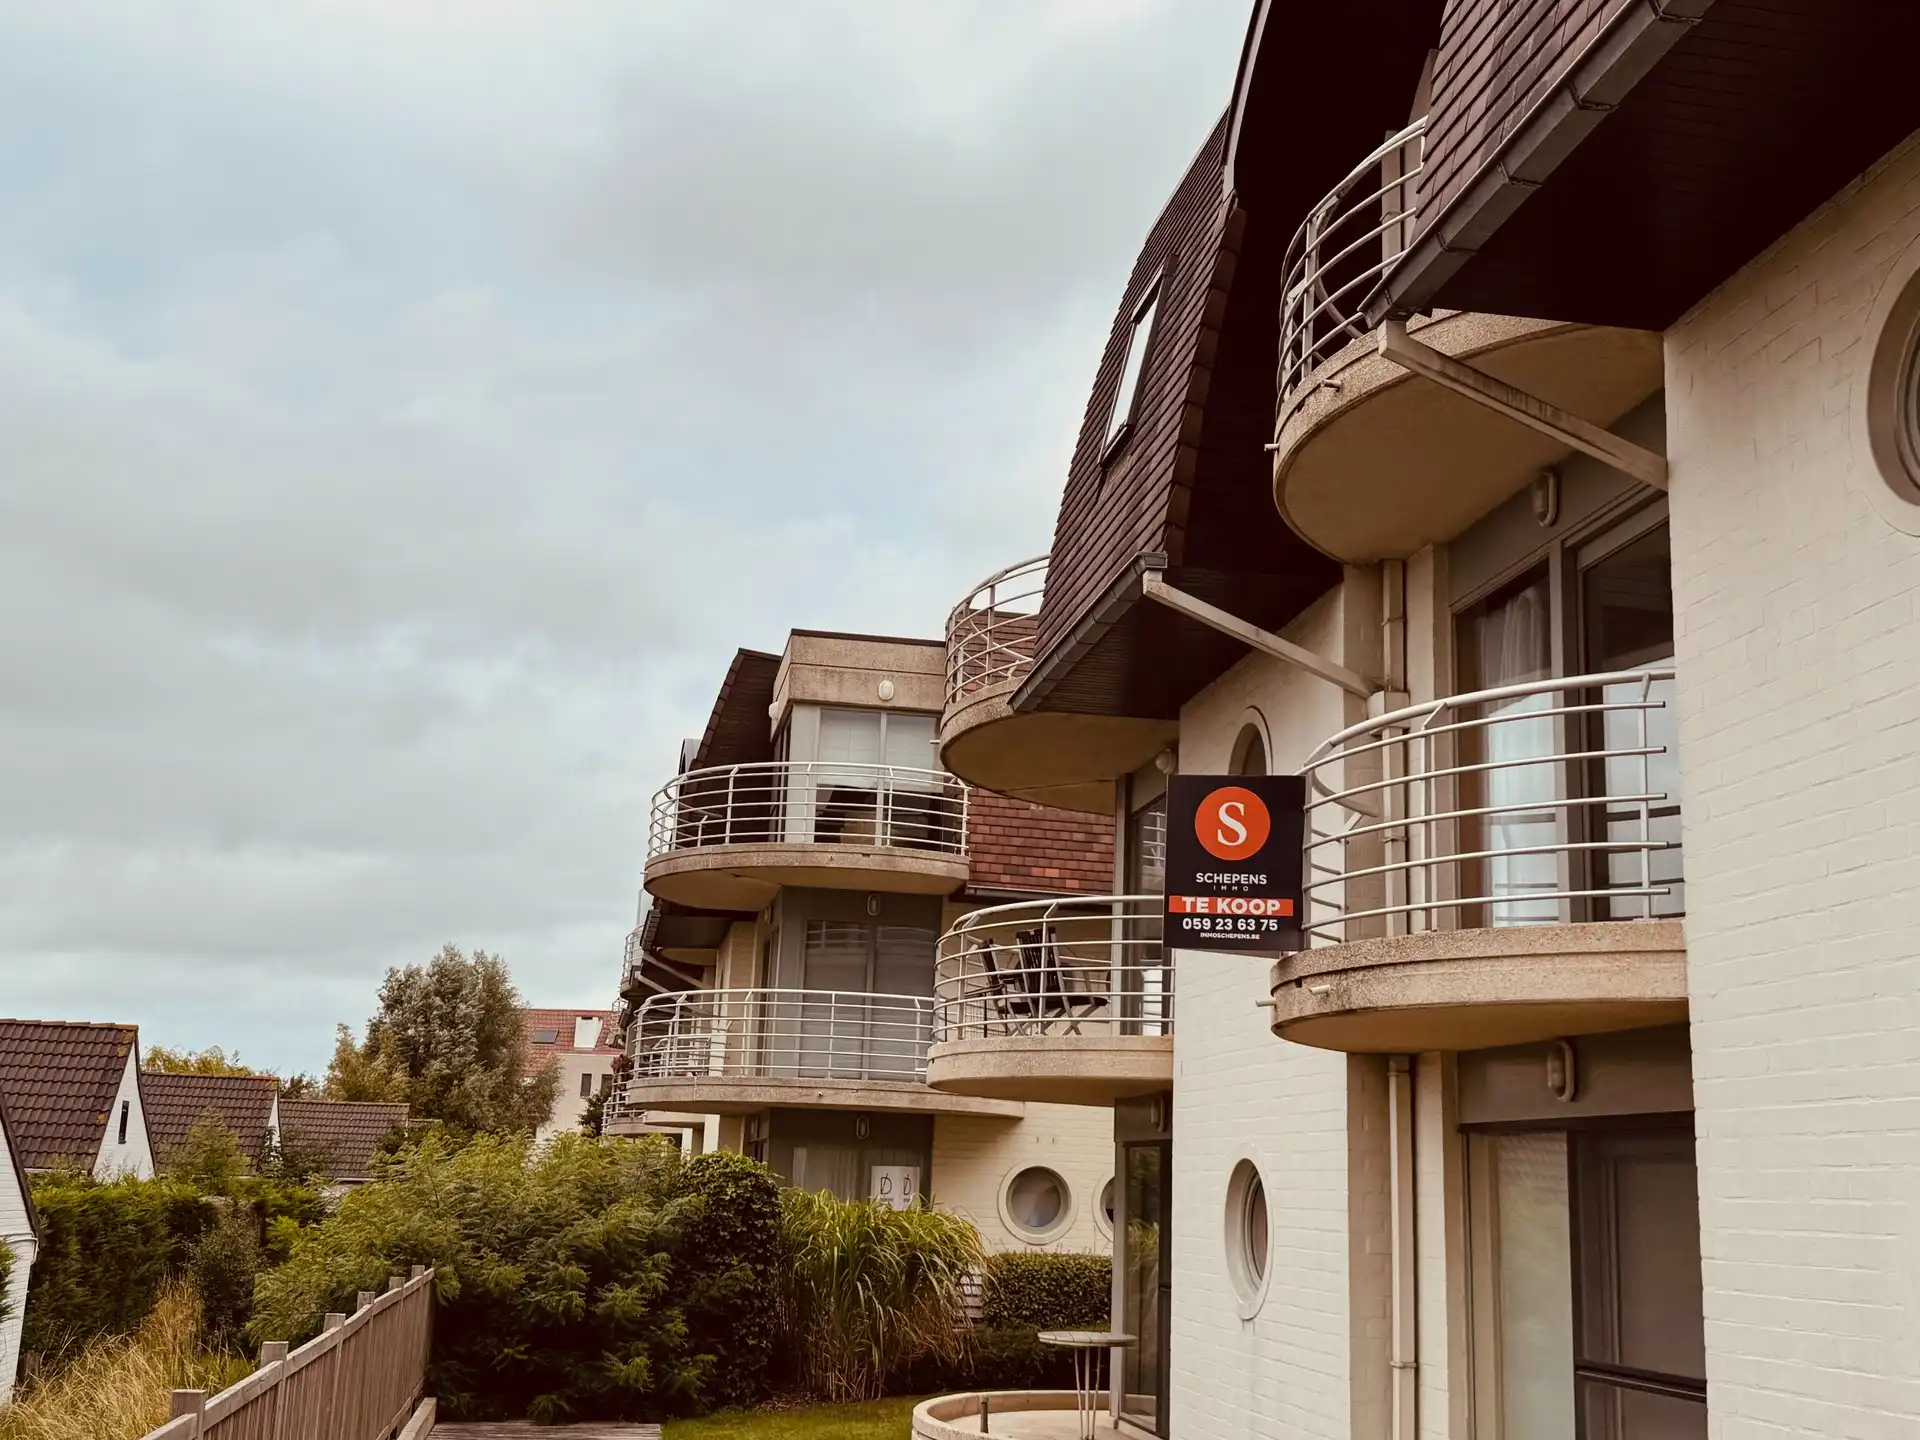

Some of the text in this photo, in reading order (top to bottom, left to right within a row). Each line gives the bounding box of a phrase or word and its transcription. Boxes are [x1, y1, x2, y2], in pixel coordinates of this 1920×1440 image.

[1217, 801, 1247, 846] S
[1195, 872, 1268, 885] SCHEPENS
[1182, 896, 1281, 915] TE KOOP
[1182, 917, 1278, 931] 059 23 63 75
[1199, 932, 1261, 940] IMMOSCHEPENS.BE
